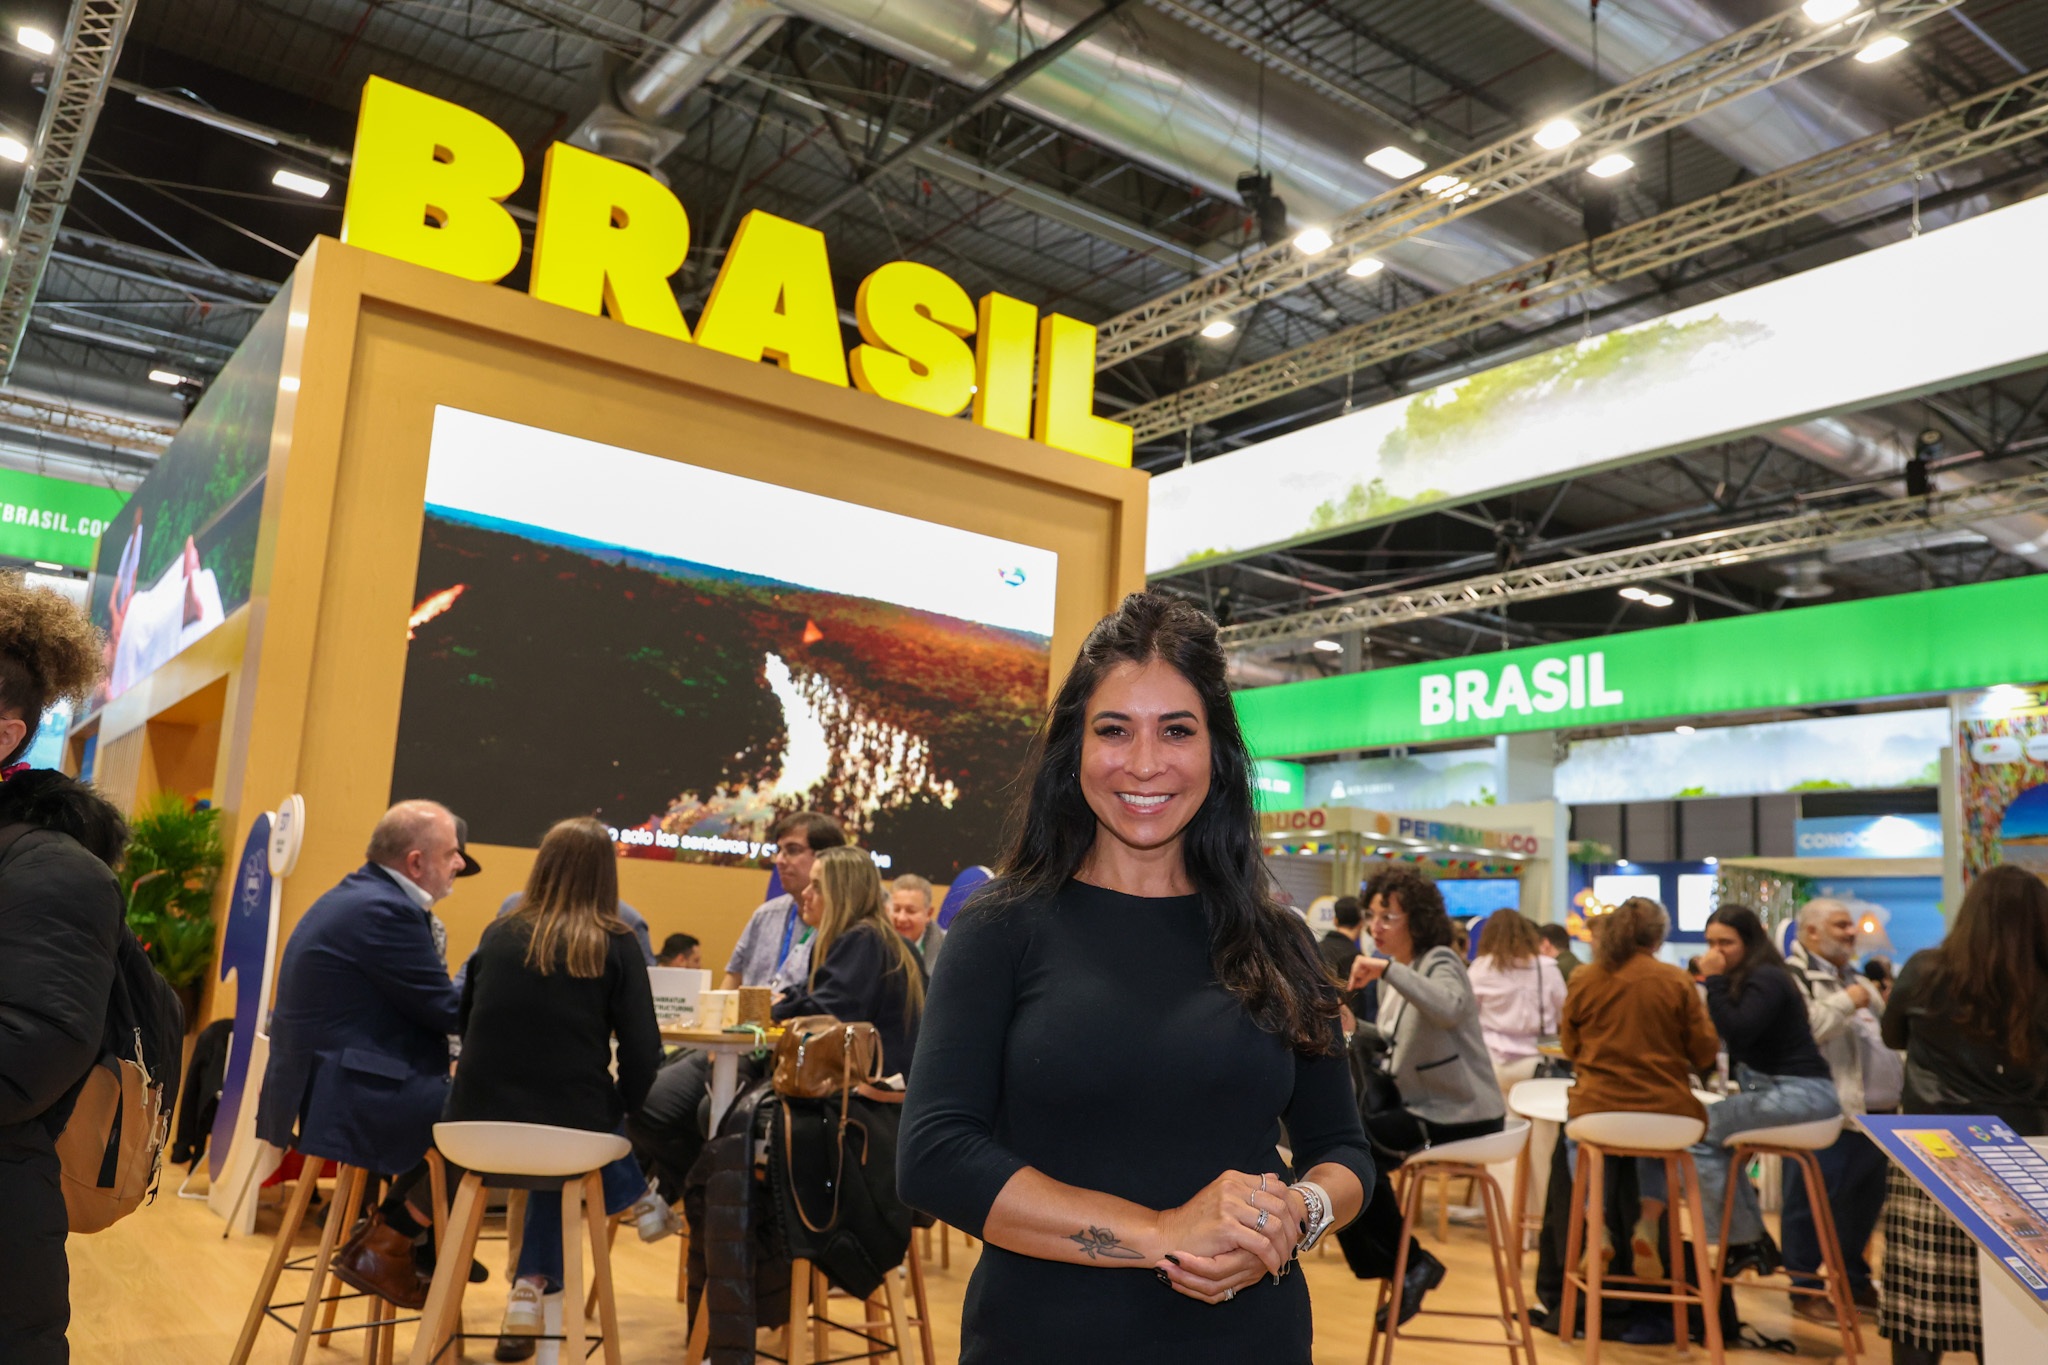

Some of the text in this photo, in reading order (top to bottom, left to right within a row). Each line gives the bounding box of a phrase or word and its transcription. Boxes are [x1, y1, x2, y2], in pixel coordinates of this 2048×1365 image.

[341, 75, 1134, 469] BRASIL
[0, 501, 112, 538] BRASIL.CO
[1419, 651, 1624, 726] BRASIL
[620, 827, 655, 846] solo
[655, 828, 680, 848] los
[749, 842, 761, 859] y
